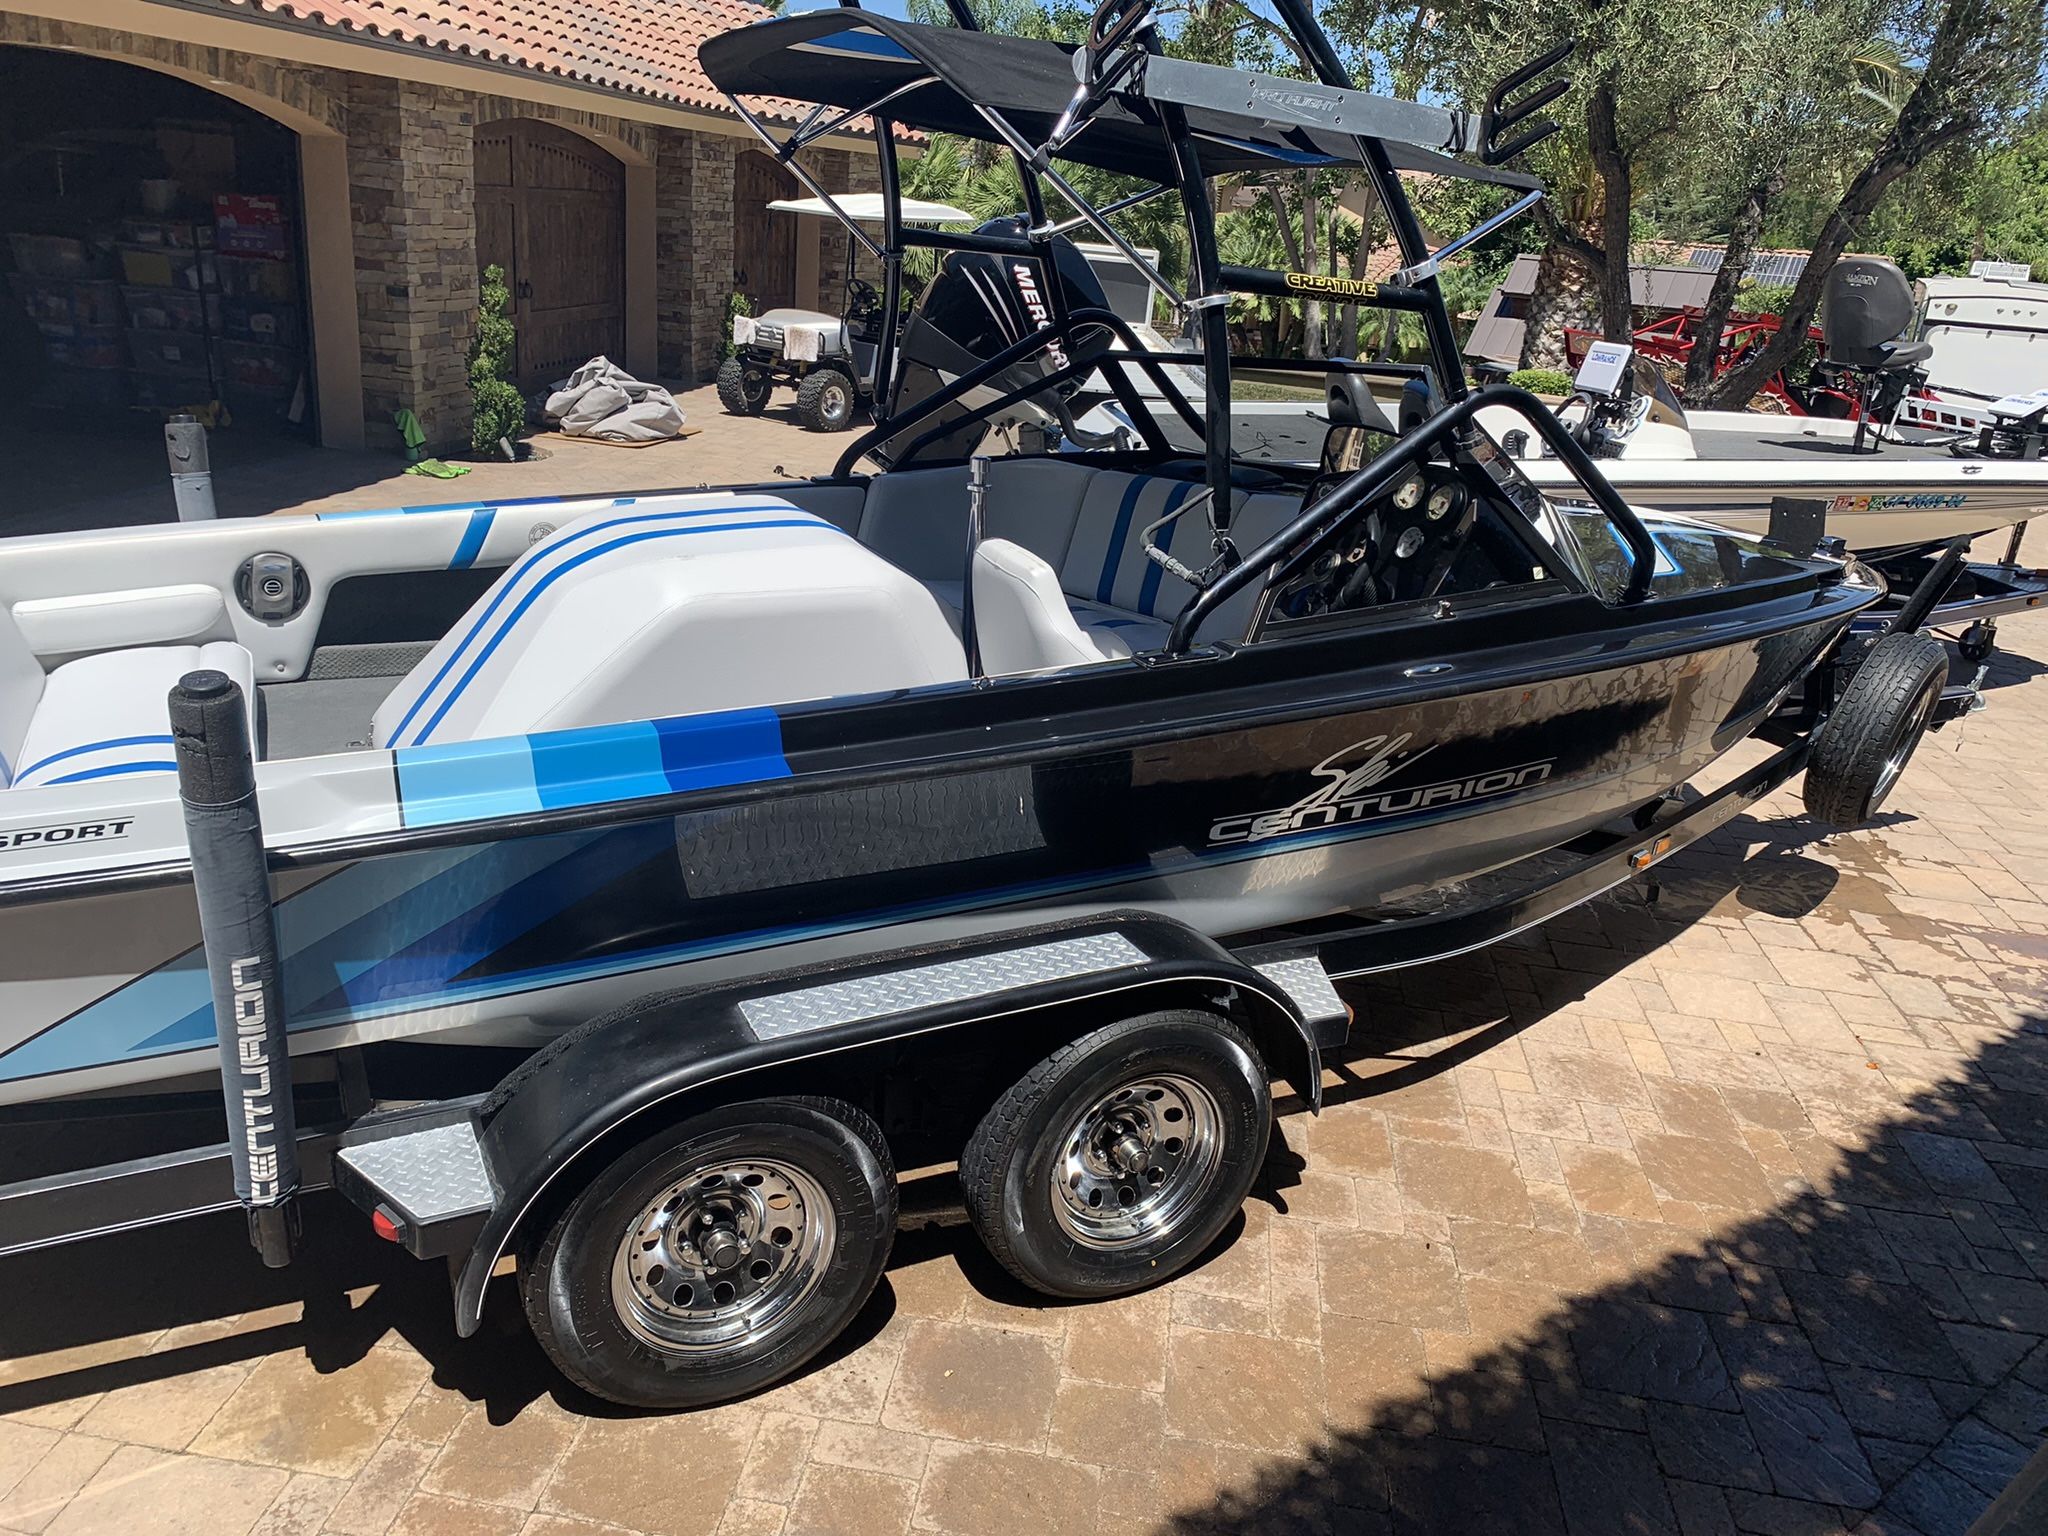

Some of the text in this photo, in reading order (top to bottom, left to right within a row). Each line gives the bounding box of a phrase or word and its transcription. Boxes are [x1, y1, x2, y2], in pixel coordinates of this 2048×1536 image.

[1013, 264, 1071, 371] MERUR
[1286, 273, 1378, 297] CREATIVE
[1208, 763, 1552, 842] CENTURION
[231, 956, 279, 1204] CENTURION
